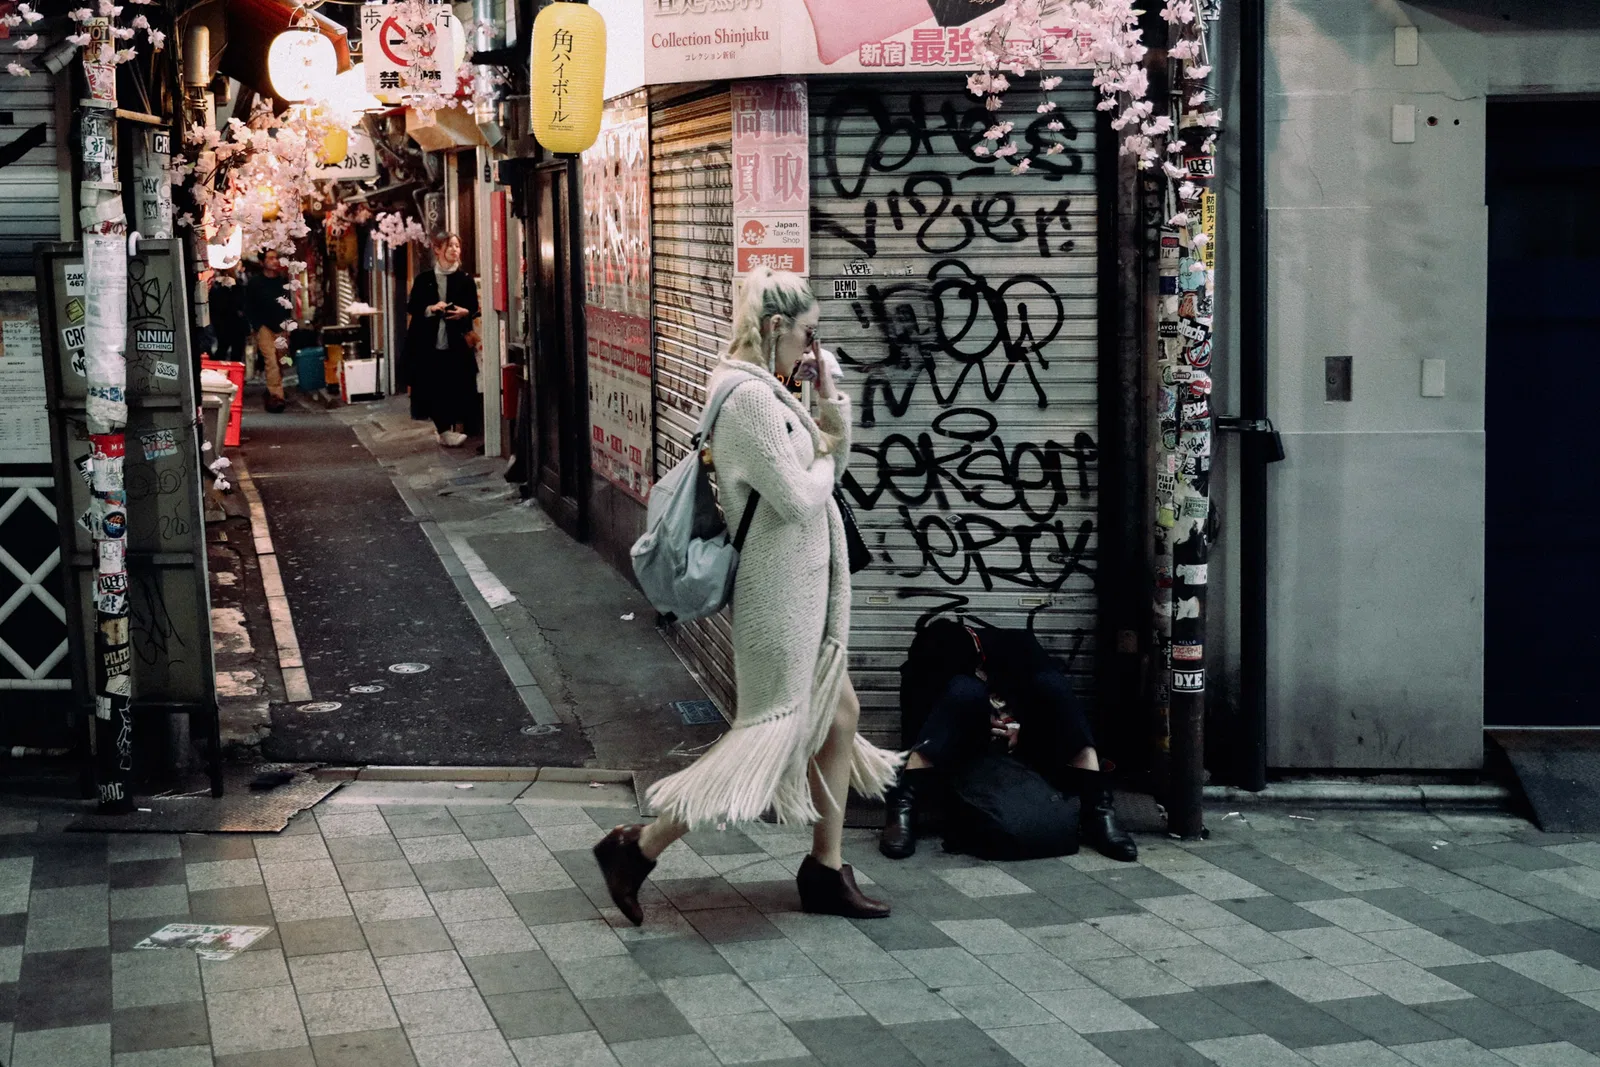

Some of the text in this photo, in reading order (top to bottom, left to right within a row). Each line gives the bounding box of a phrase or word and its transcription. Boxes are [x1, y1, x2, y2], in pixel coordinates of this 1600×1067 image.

[651, 26, 769, 49] Collection Shinjuku
[685, 51, 736, 62] コレクション新宿
[551, 28, 573, 124] 角ハイボール
[736, 151, 804, 203] 買取
[774, 221, 800, 229] Japan.
[1206, 195, 1215, 269] 防犯カメラ録画中
[782, 237, 800, 245] Shop
[747, 254, 794, 270] 免税店
[834, 280, 857, 291] DEMO
[137, 330, 174, 342] NNIM
[138, 343, 172, 351] CLOTHING
[1174, 672, 1203, 686] D.Y.E
